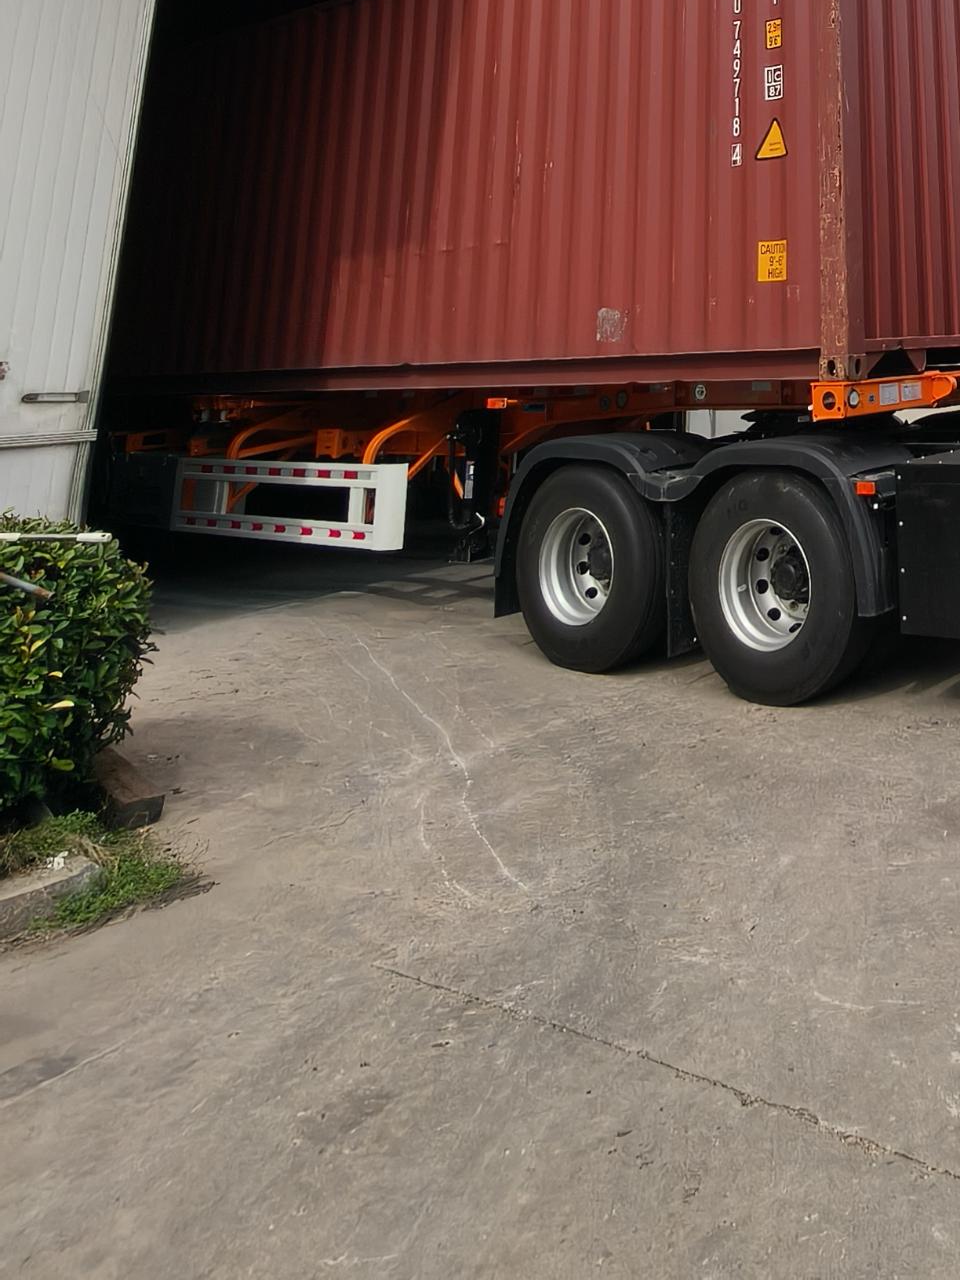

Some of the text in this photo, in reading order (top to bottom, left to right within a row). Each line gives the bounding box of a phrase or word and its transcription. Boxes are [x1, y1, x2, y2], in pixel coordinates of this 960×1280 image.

[732, 20, 742, 137] 749718
[768, 84, 781, 97] 87
[760, 242, 785, 255] CAUTIO
